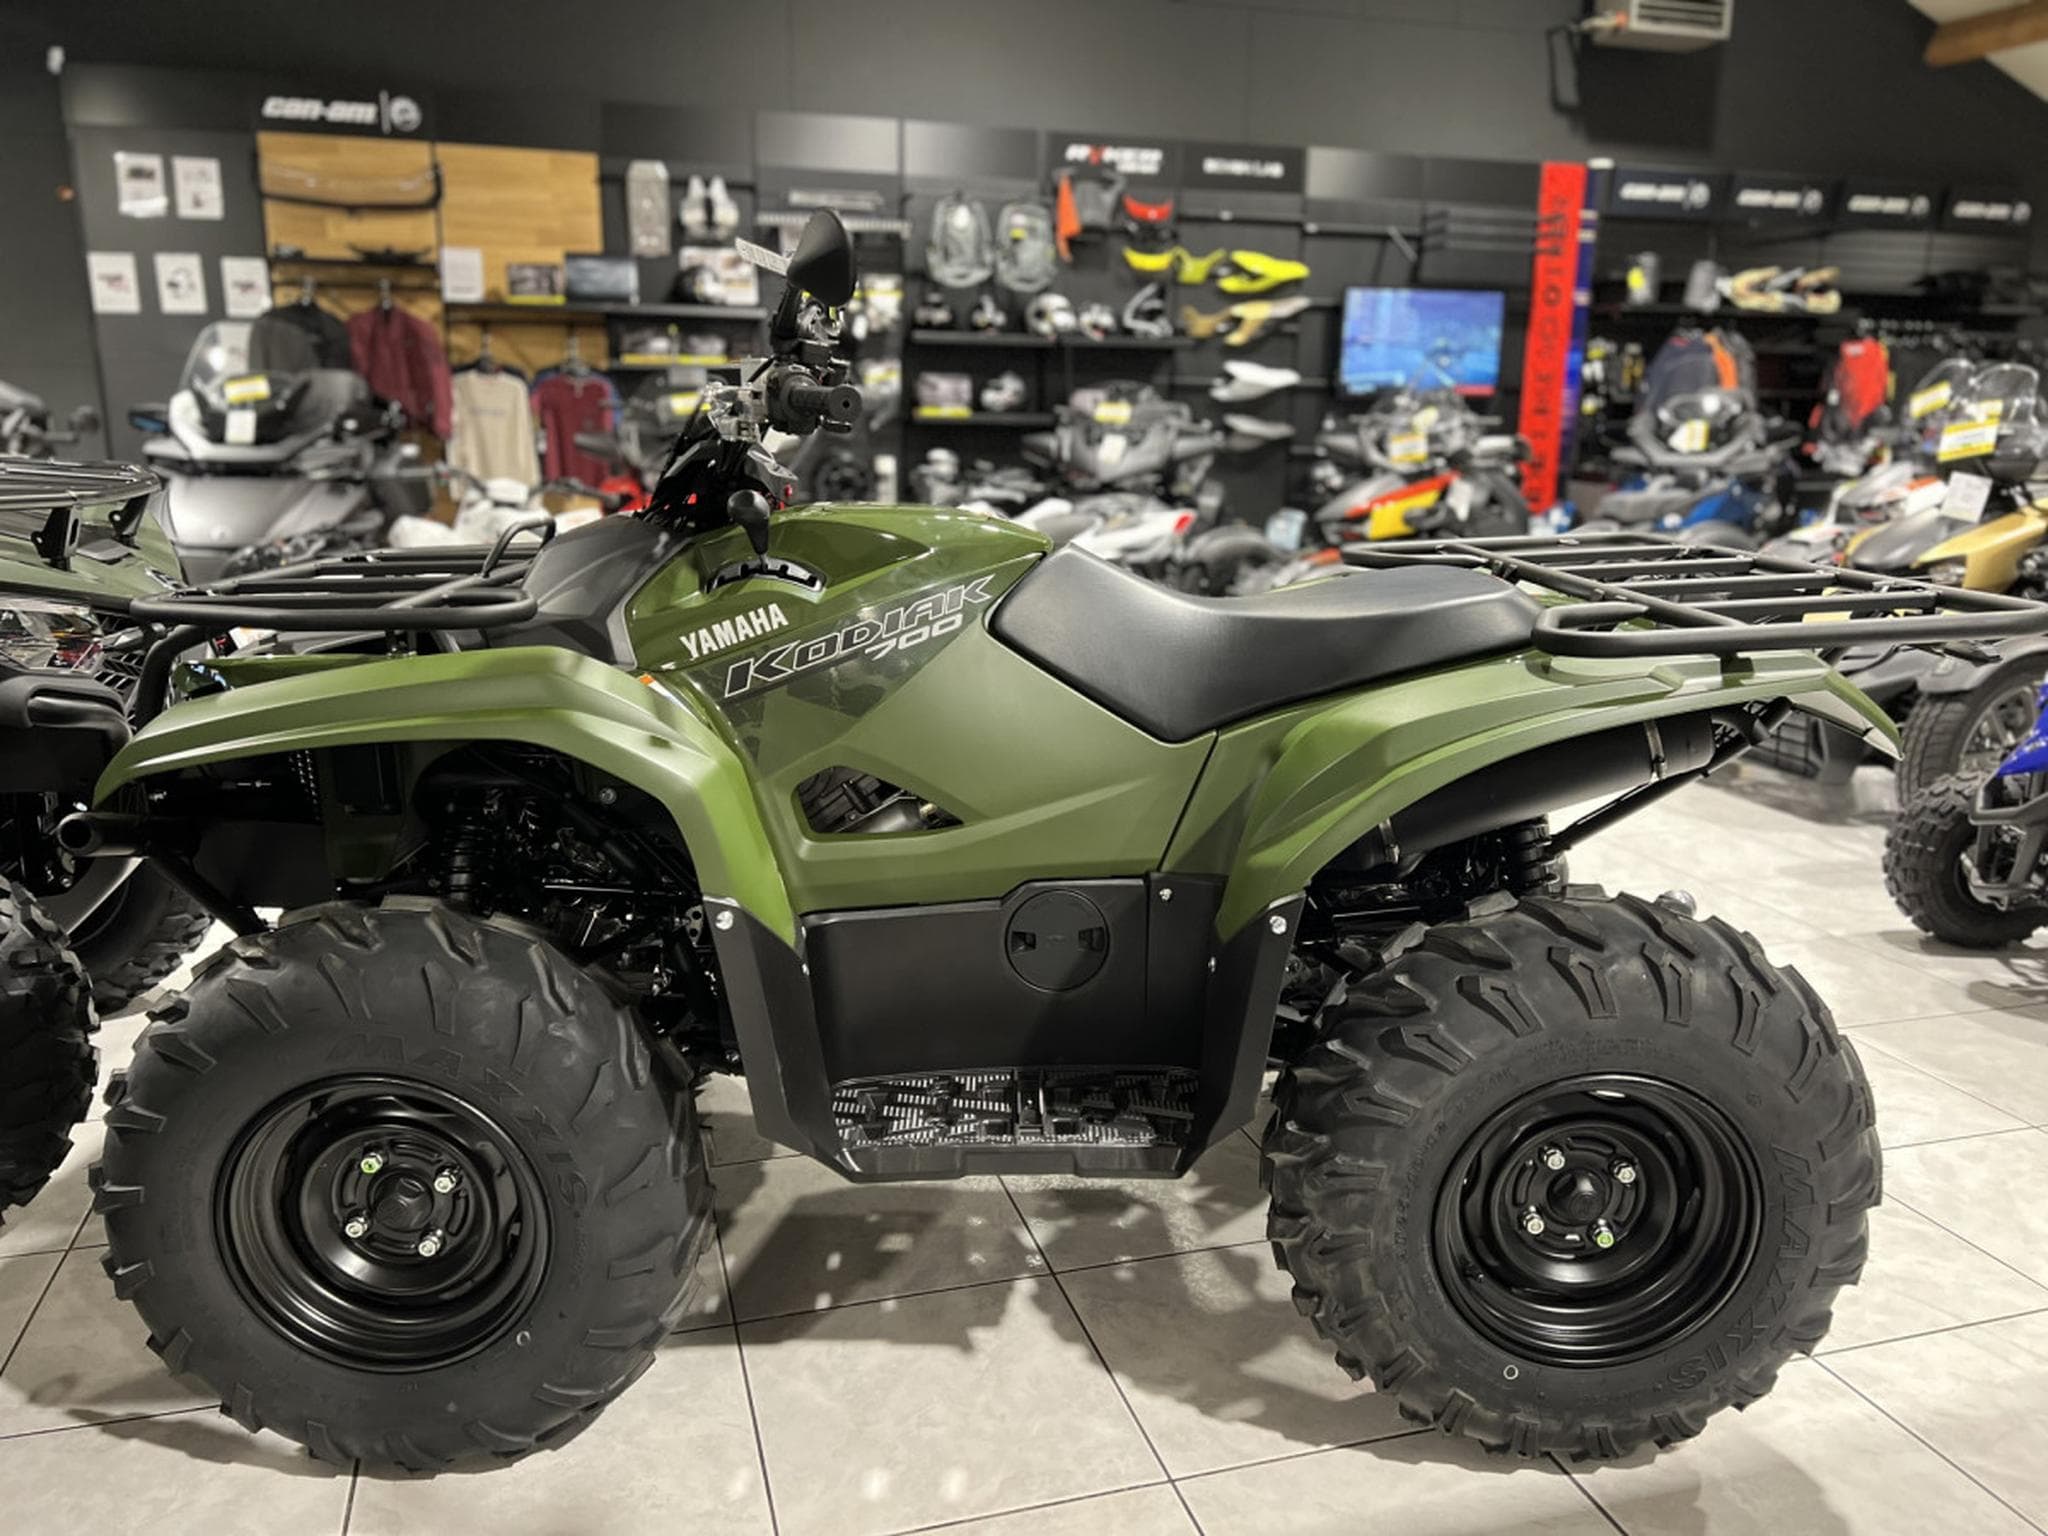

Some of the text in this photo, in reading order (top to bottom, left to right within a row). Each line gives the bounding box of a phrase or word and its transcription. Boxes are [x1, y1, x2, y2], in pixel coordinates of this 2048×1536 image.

[680, 603, 789, 660] YAMAHA
[724, 573, 996, 698] KODIAK
[864, 613, 963, 661] 700
[1667, 1142, 1815, 1391] MAXXIS
